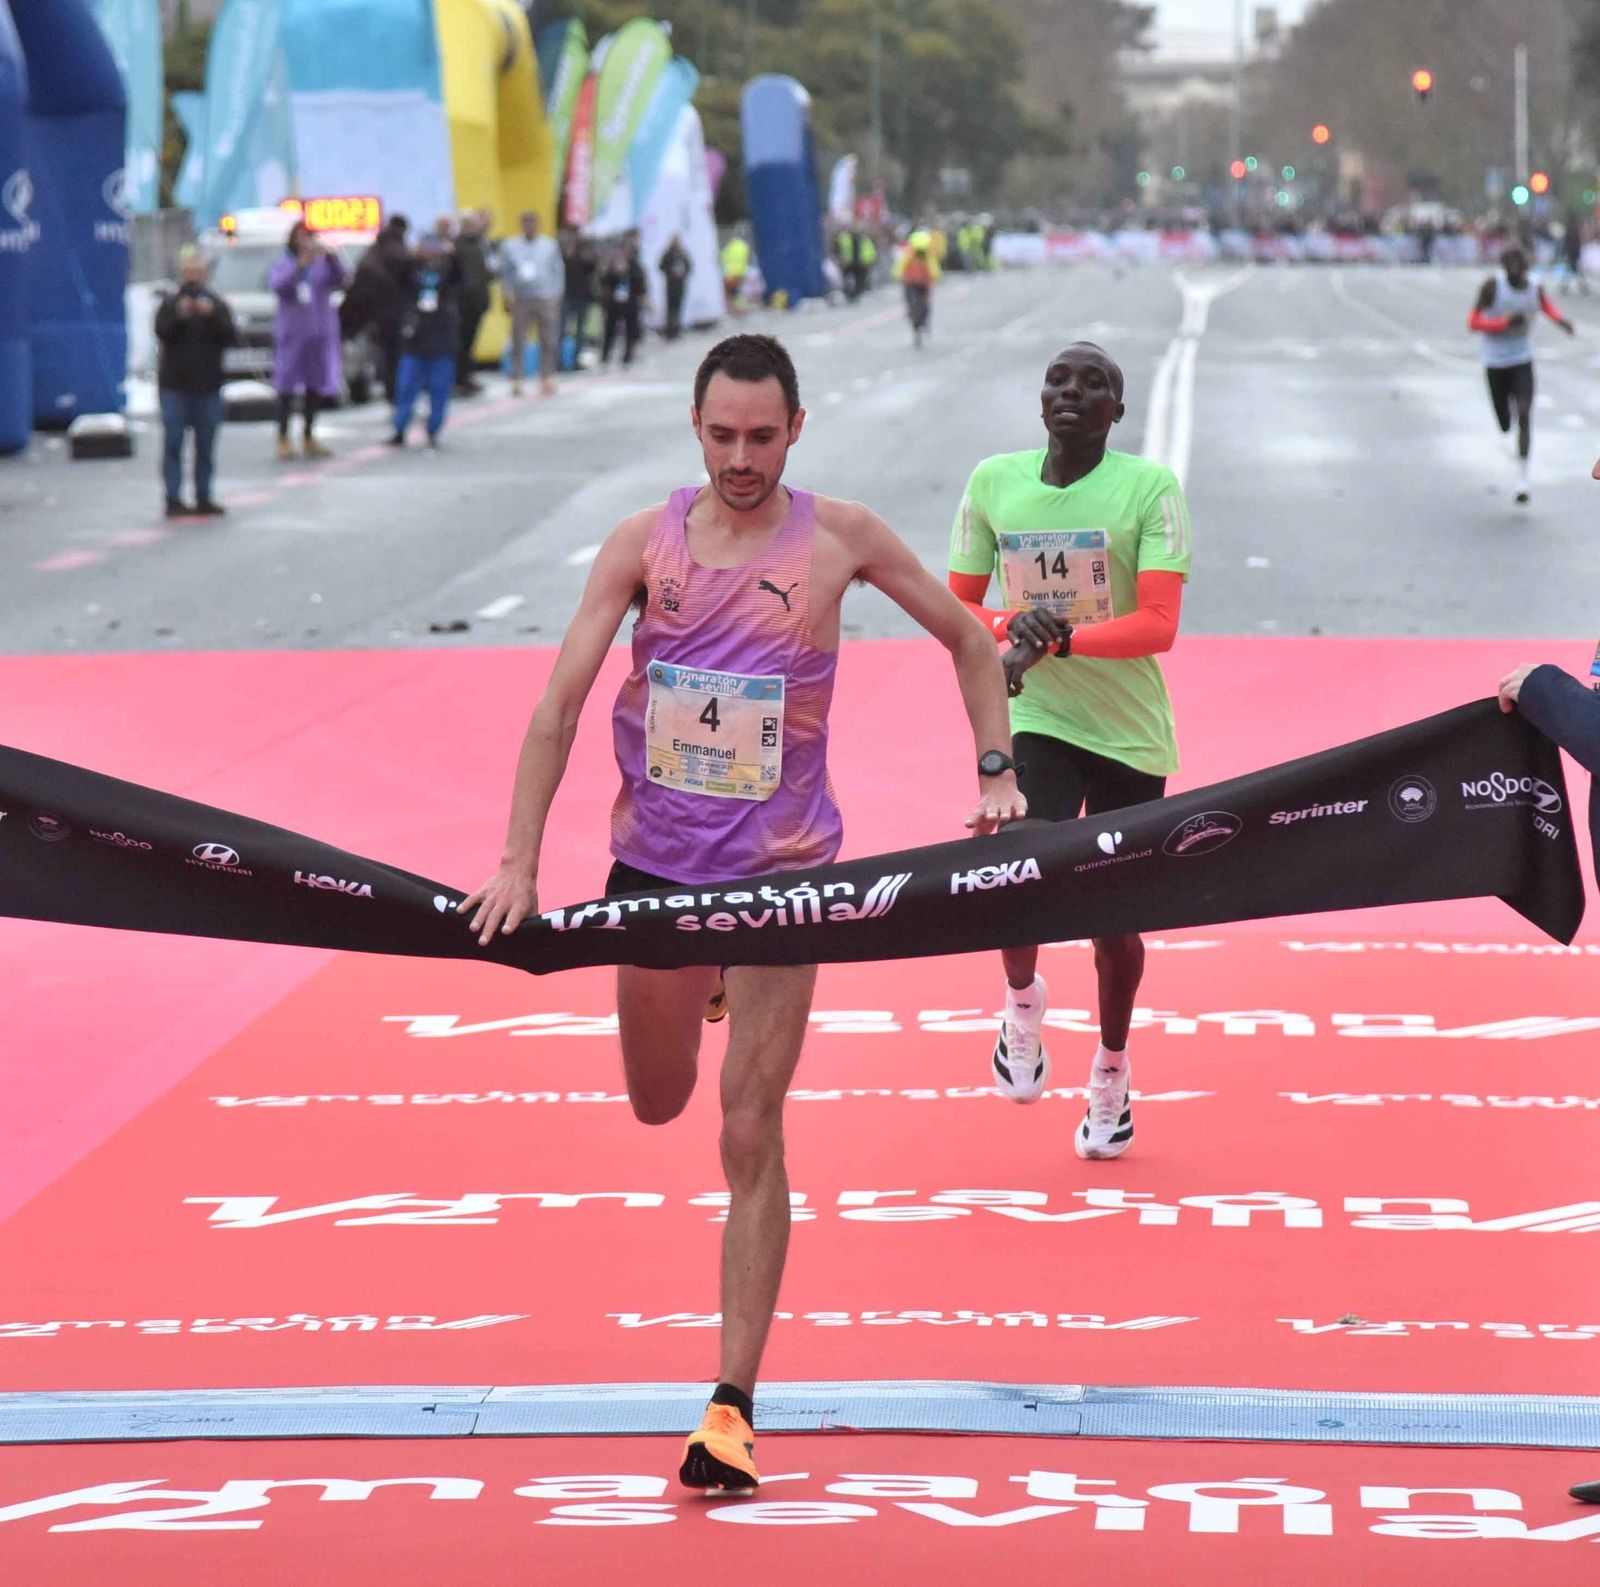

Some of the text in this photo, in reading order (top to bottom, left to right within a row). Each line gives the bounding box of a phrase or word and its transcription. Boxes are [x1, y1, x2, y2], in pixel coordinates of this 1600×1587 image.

[1034, 550, 1069, 580] 14
[1022, 588, 1078, 601] Owen Korir
[700, 681, 737, 695] sevilla
[699, 697, 721, 732] 4
[672, 739, 737, 760] Emmanuel
[1268, 799, 1369, 825] Sprinter
[185, 858, 253, 876] HYUNDAI
[951, 858, 1042, 895] HOKA
[294, 870, 376, 899] HOKA
[606, 880, 855, 914] maratón
[676, 896, 863, 931] sevilla
[533, 1496, 1530, 1541] sevilla
